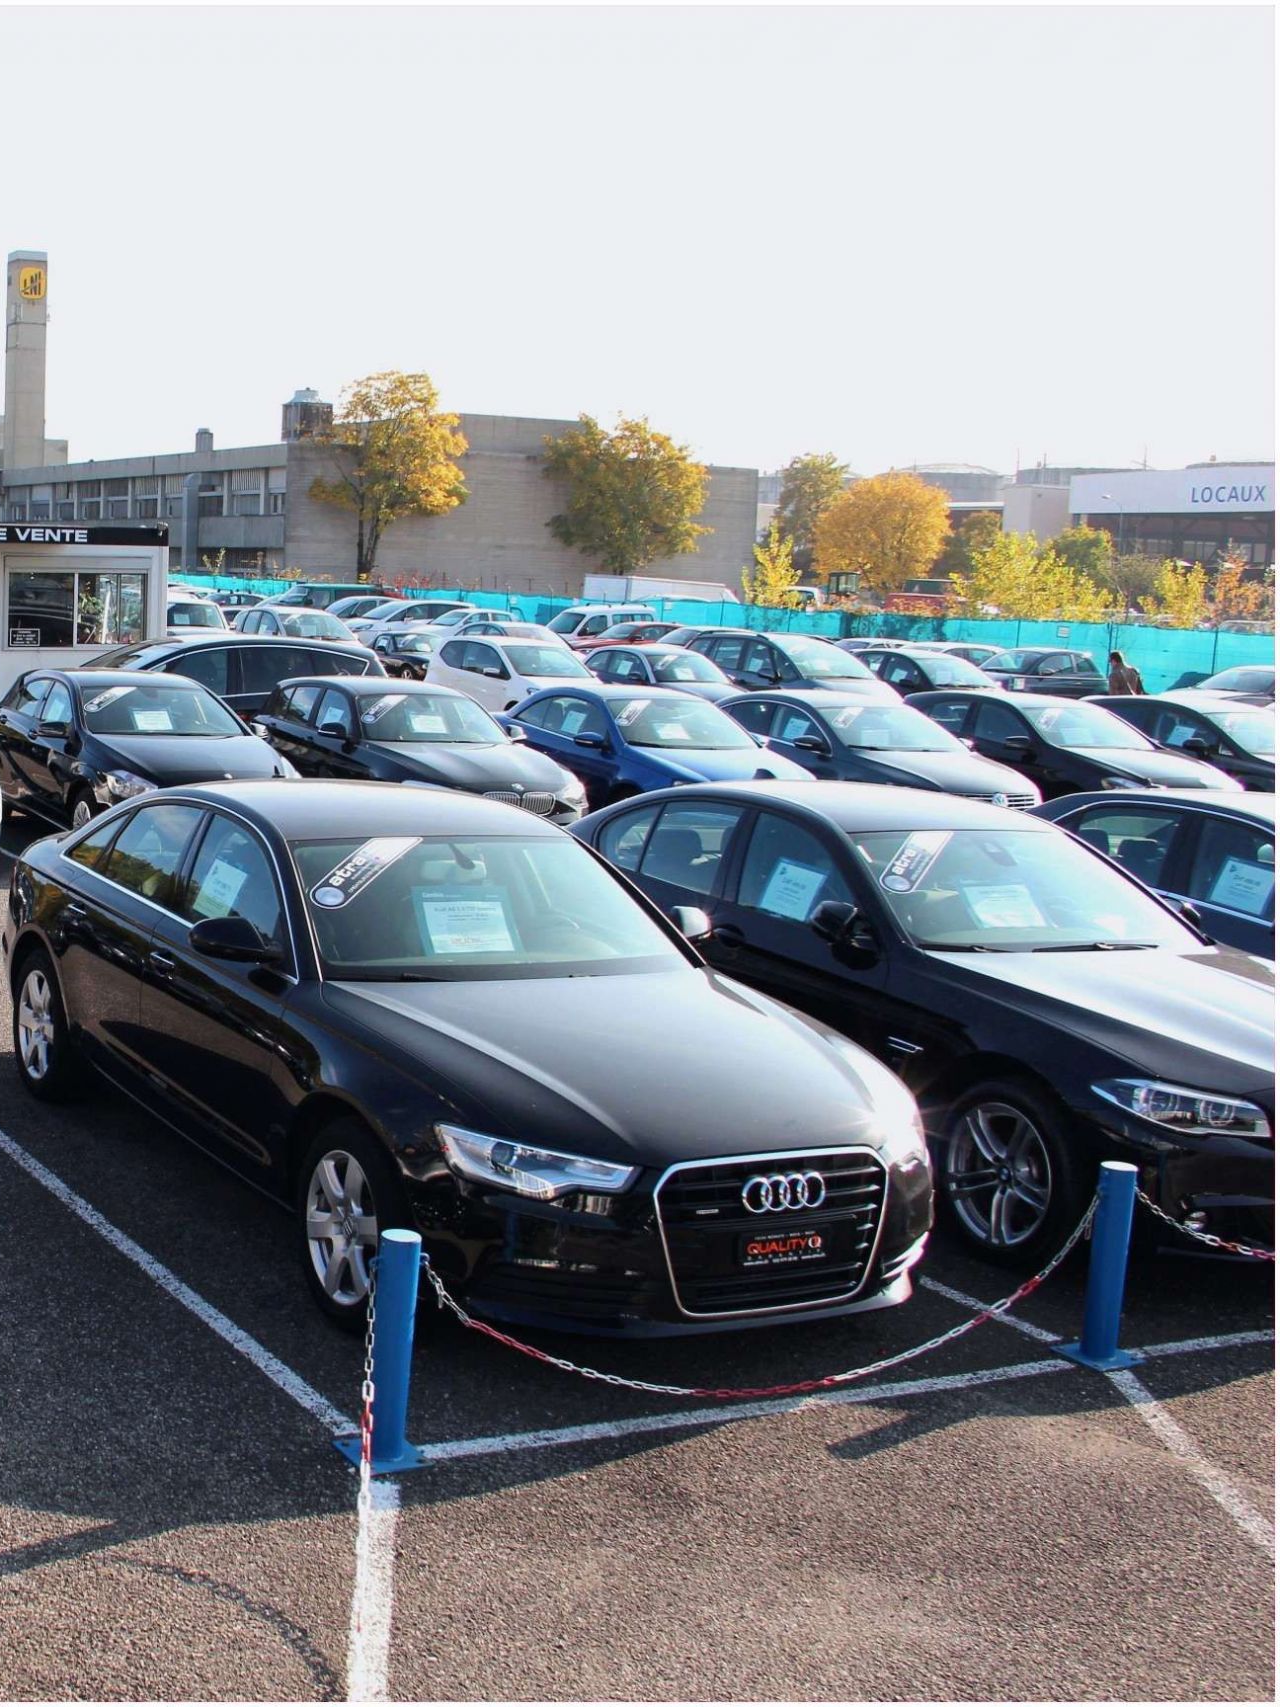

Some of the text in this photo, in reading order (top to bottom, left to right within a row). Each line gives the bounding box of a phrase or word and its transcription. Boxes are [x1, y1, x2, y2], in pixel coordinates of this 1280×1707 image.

[1191, 485, 1267, 503] LOCAUX
[16, 528, 88, 542] VENTE
[329, 856, 367, 887] atra
